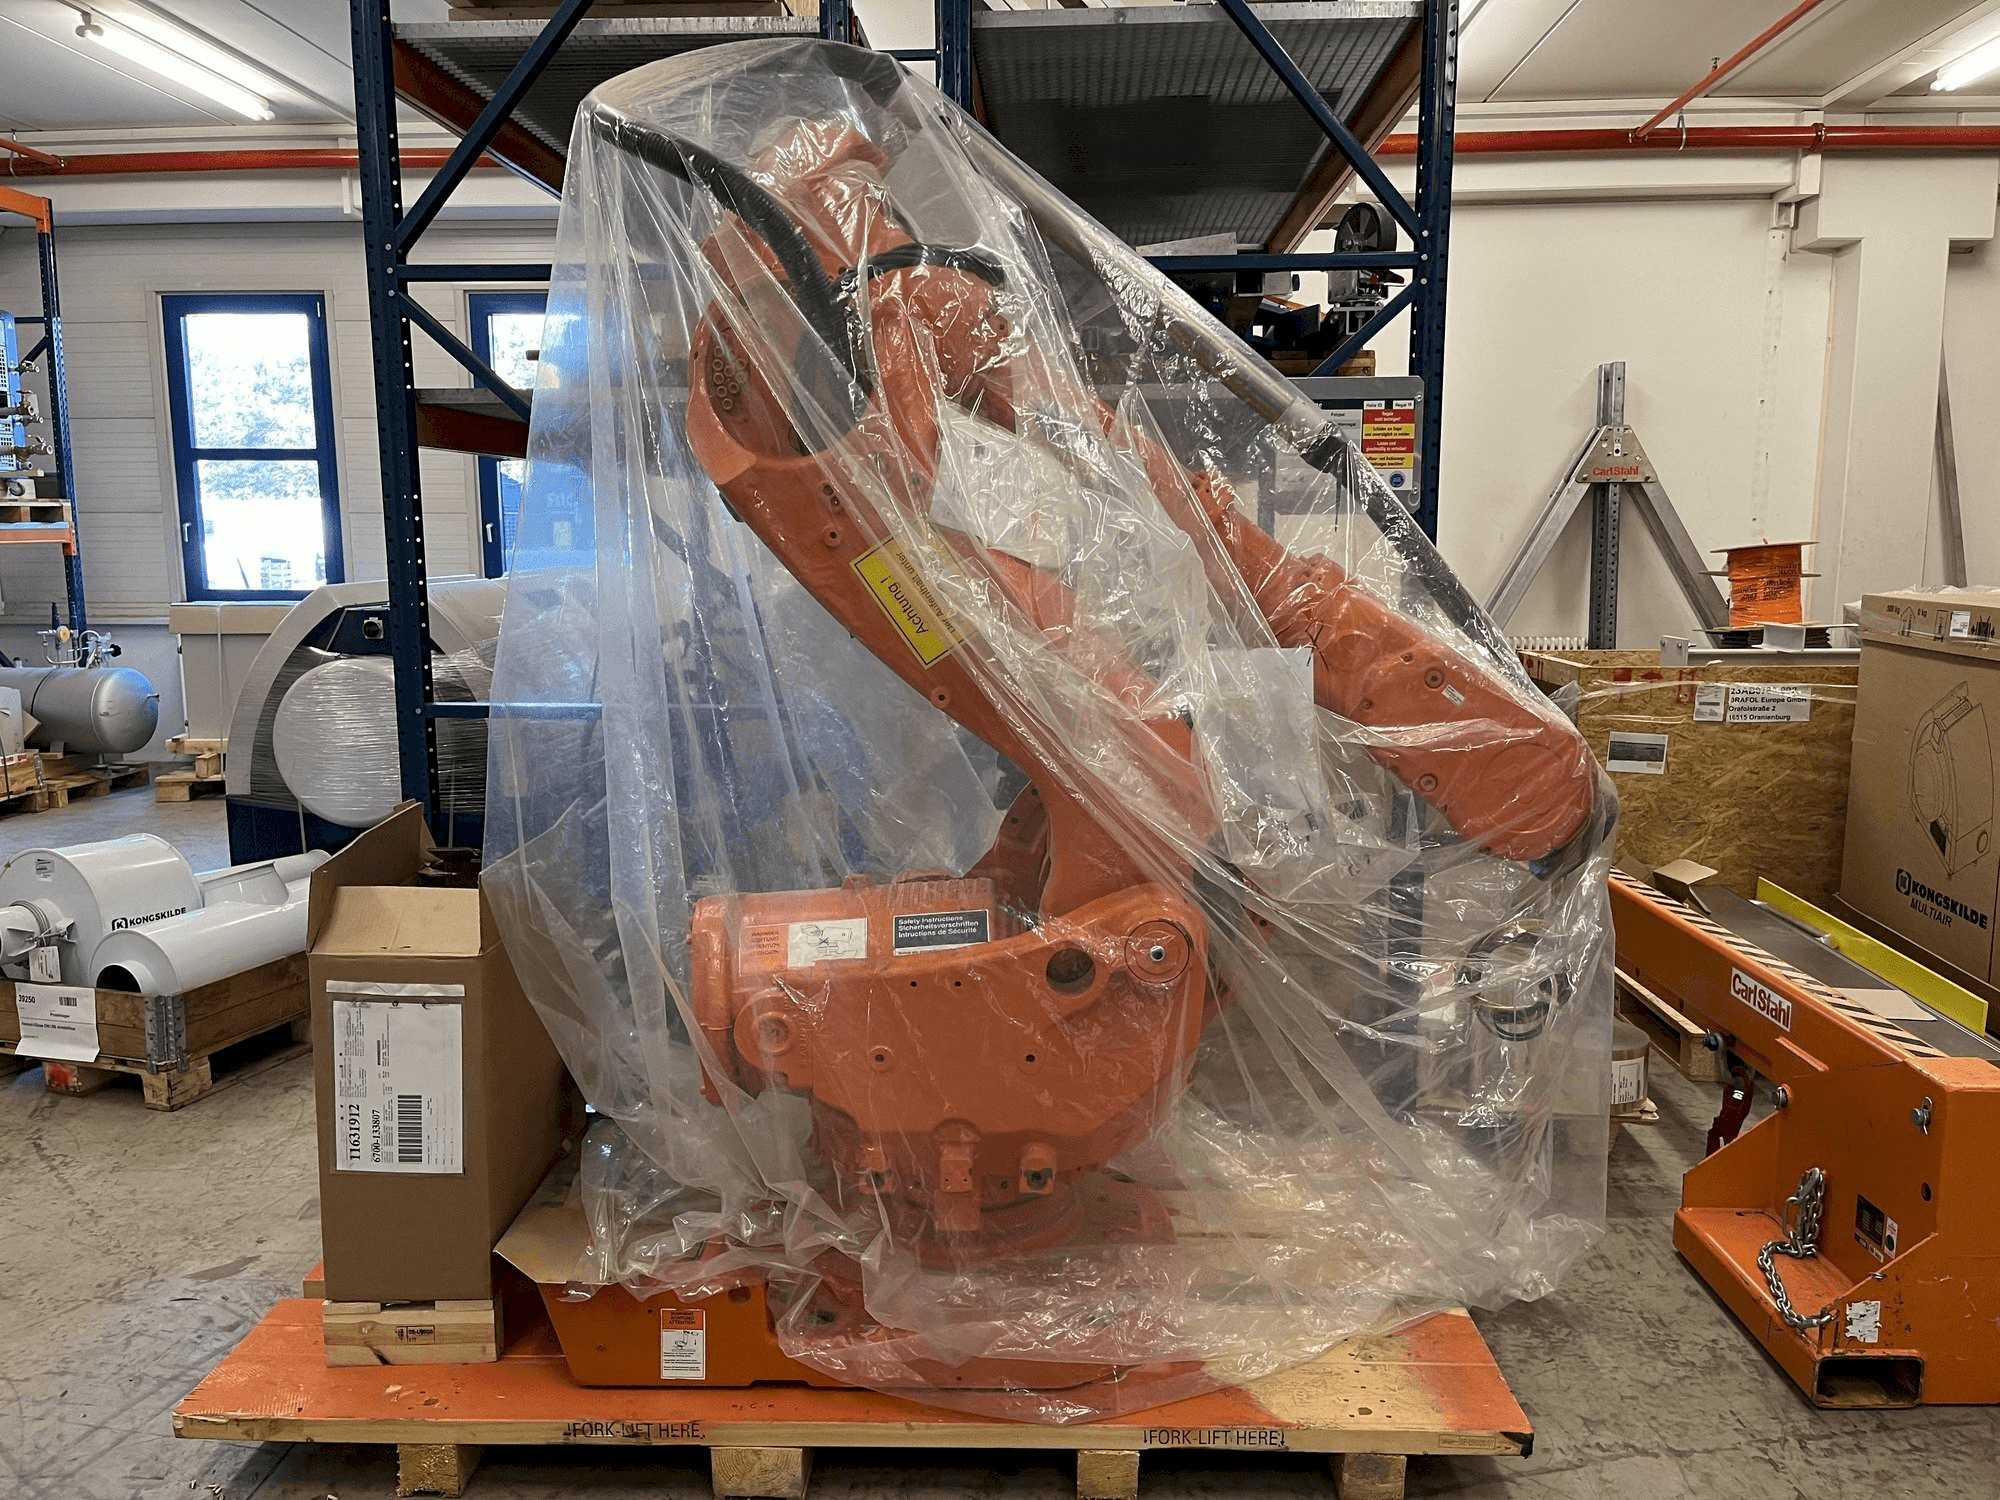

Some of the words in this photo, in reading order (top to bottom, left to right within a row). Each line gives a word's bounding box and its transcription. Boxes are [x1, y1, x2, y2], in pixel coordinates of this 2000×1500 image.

[896, 552, 915, 574] unter
[887, 581, 929, 635] Achtung
[129, 907, 187, 927] KONGSKILDE
[1910, 897, 1953, 928] MULTIAIR
[1911, 880, 1988, 930] KONGSKILDE
[921, 915, 964, 923] Instructions
[348, 1104, 361, 1161] 11631912
[371, 1109, 381, 1163] 6700-133807
[659, 1421, 701, 1439] HERE
[1149, 1429, 1232, 1445] FORK-LIFT
[1236, 1430, 1278, 1446] HERE
